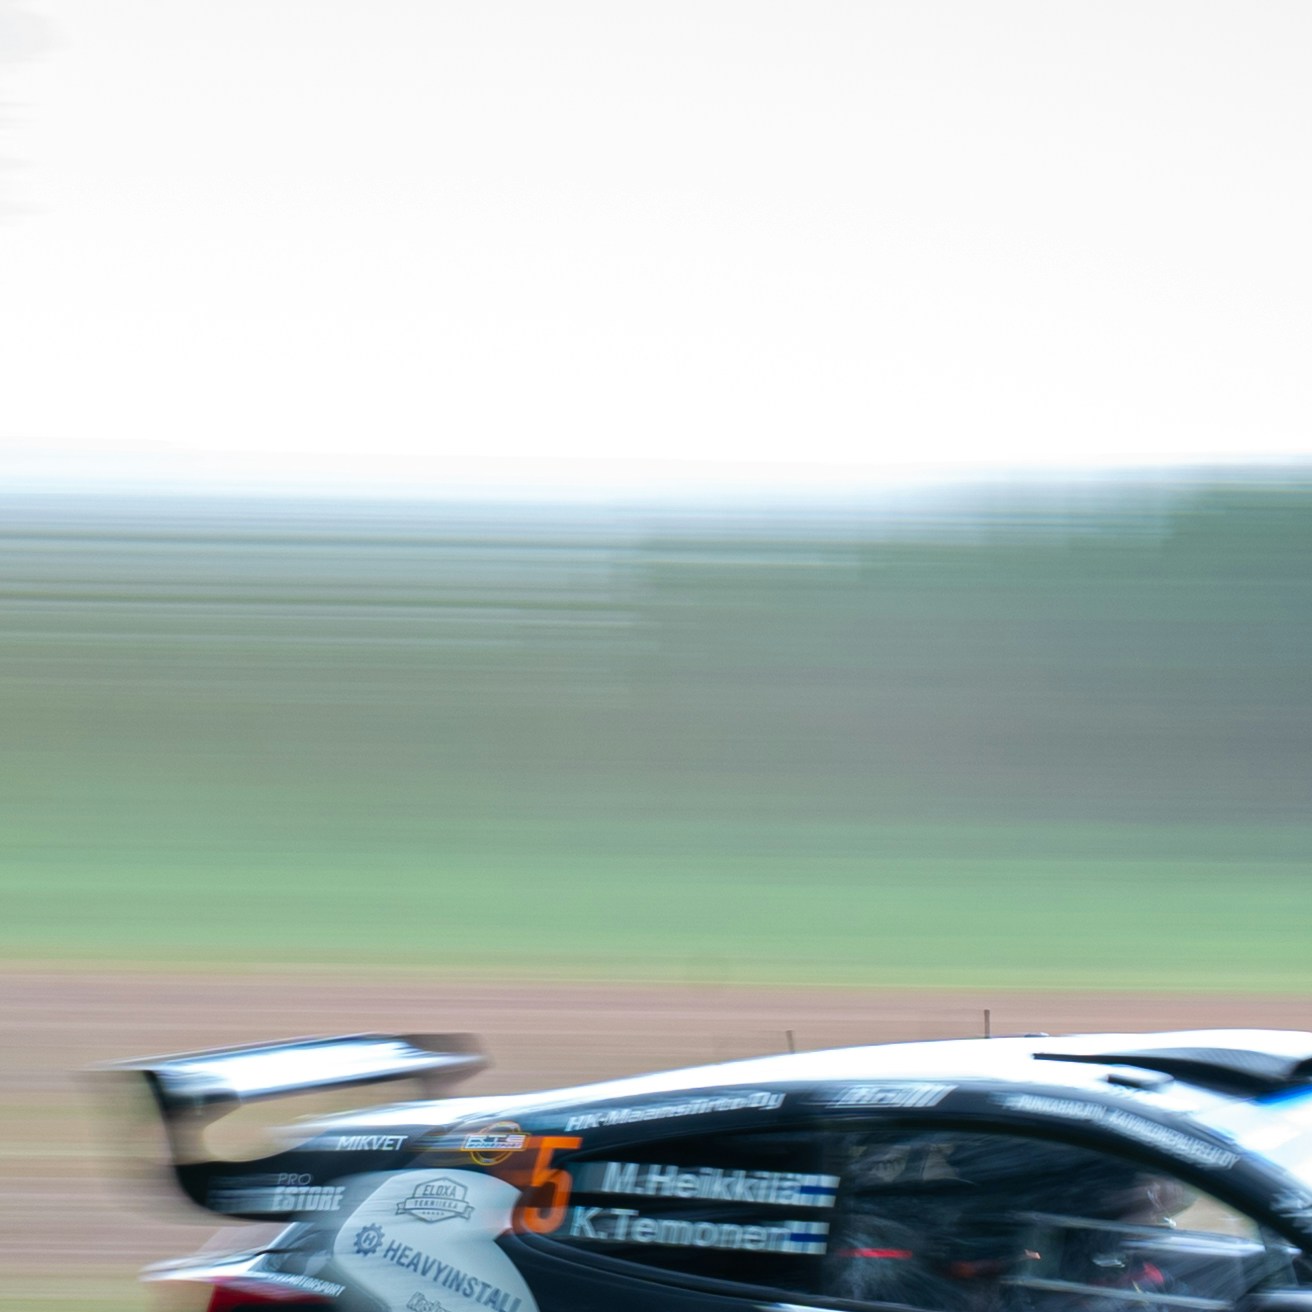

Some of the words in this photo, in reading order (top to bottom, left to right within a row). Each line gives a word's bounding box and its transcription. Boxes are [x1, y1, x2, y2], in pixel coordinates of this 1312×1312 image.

[338, 1135, 407, 1150] MIKVET
[277, 1173, 312, 1185] PRO
[422, 1184, 457, 1198] ELOXA
[518, 1136, 582, 1234] 5
[601, 1162, 800, 1201] M.Heikkilä
[273, 1186, 345, 1211] ESTORE
[570, 1205, 790, 1250] K.Temonen
